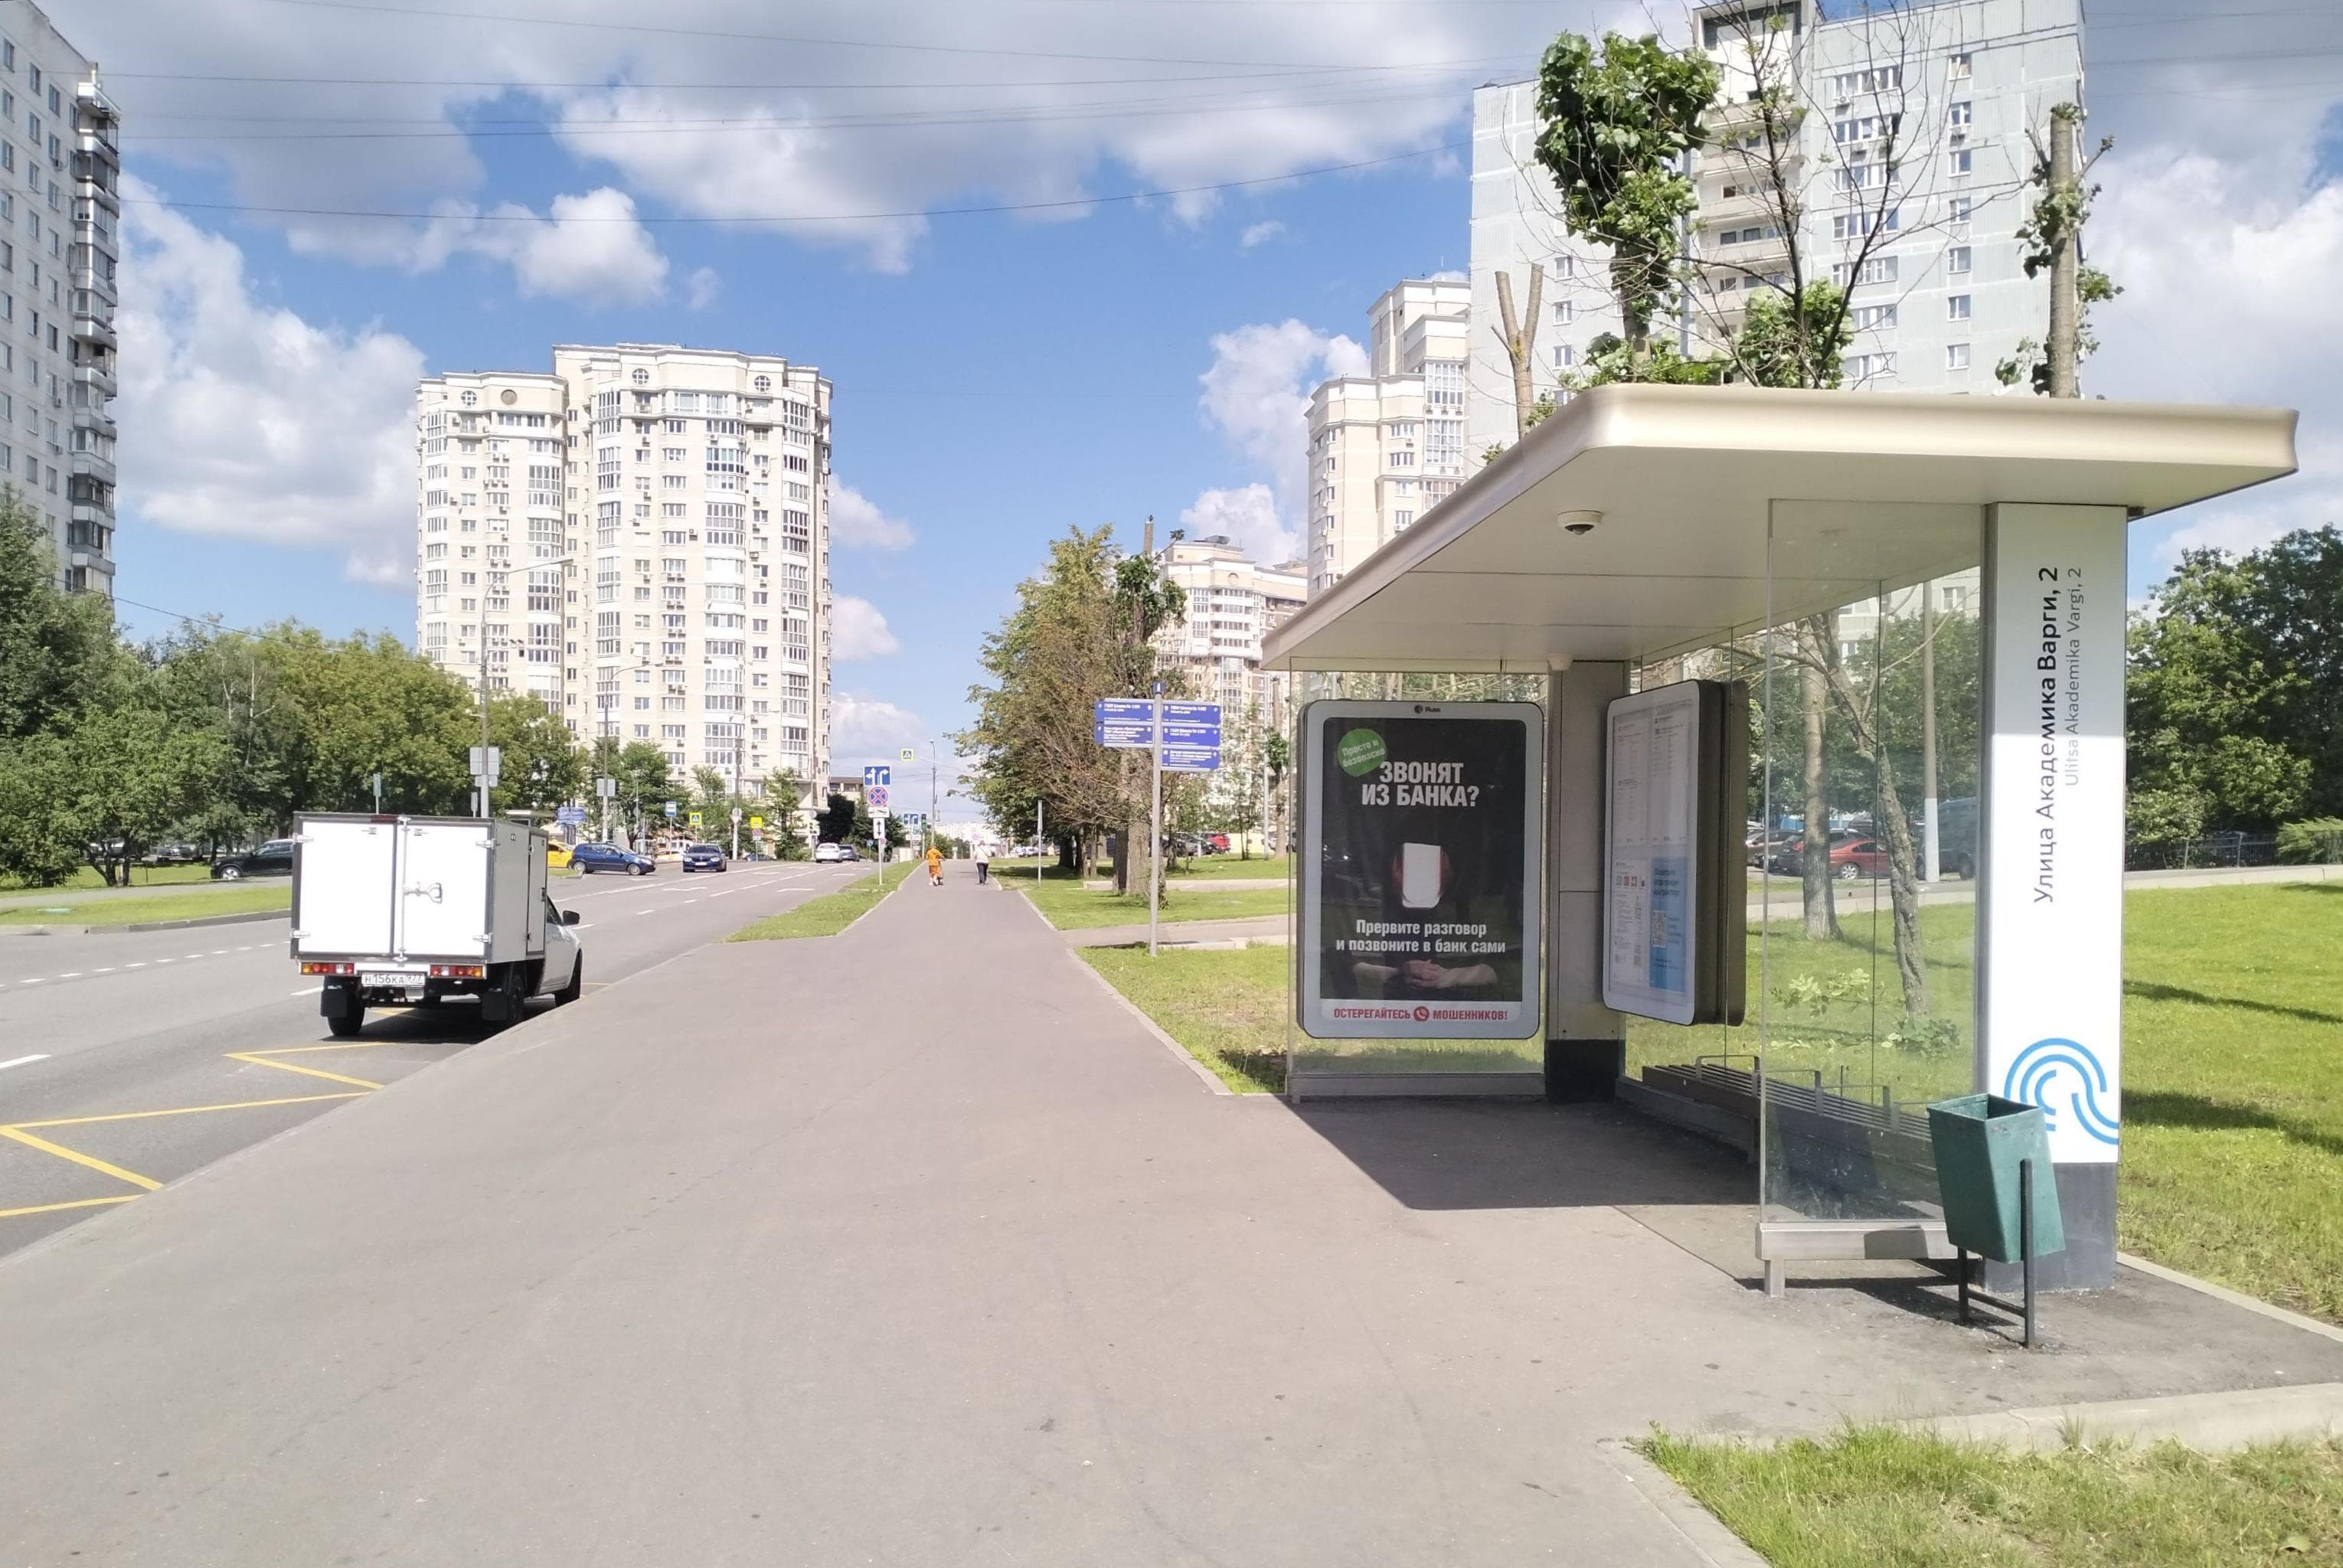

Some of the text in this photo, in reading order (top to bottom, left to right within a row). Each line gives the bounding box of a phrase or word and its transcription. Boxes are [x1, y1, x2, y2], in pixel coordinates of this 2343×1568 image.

[2064, 567, 2084, 786] Ulitsa Akademika Vargi, 2
[2034, 567, 2061, 903] Улица Академика Варги, 2
[1341, 747, 1386, 767] безопасно
[1342, 739, 1379, 758] Просто и
[1379, 761, 1464, 784] ЗВОНЯТ
[1361, 783, 1479, 807] ИЗ БАНКА?
[1356, 919, 1487, 938] Прервите разговор
[1336, 938, 1506, 953] и позвоните в банк сами
[1334, 1007, 1508, 1021] ОСТЕРЕГАЙТЕСЬ МОШЕННИКОВ!
